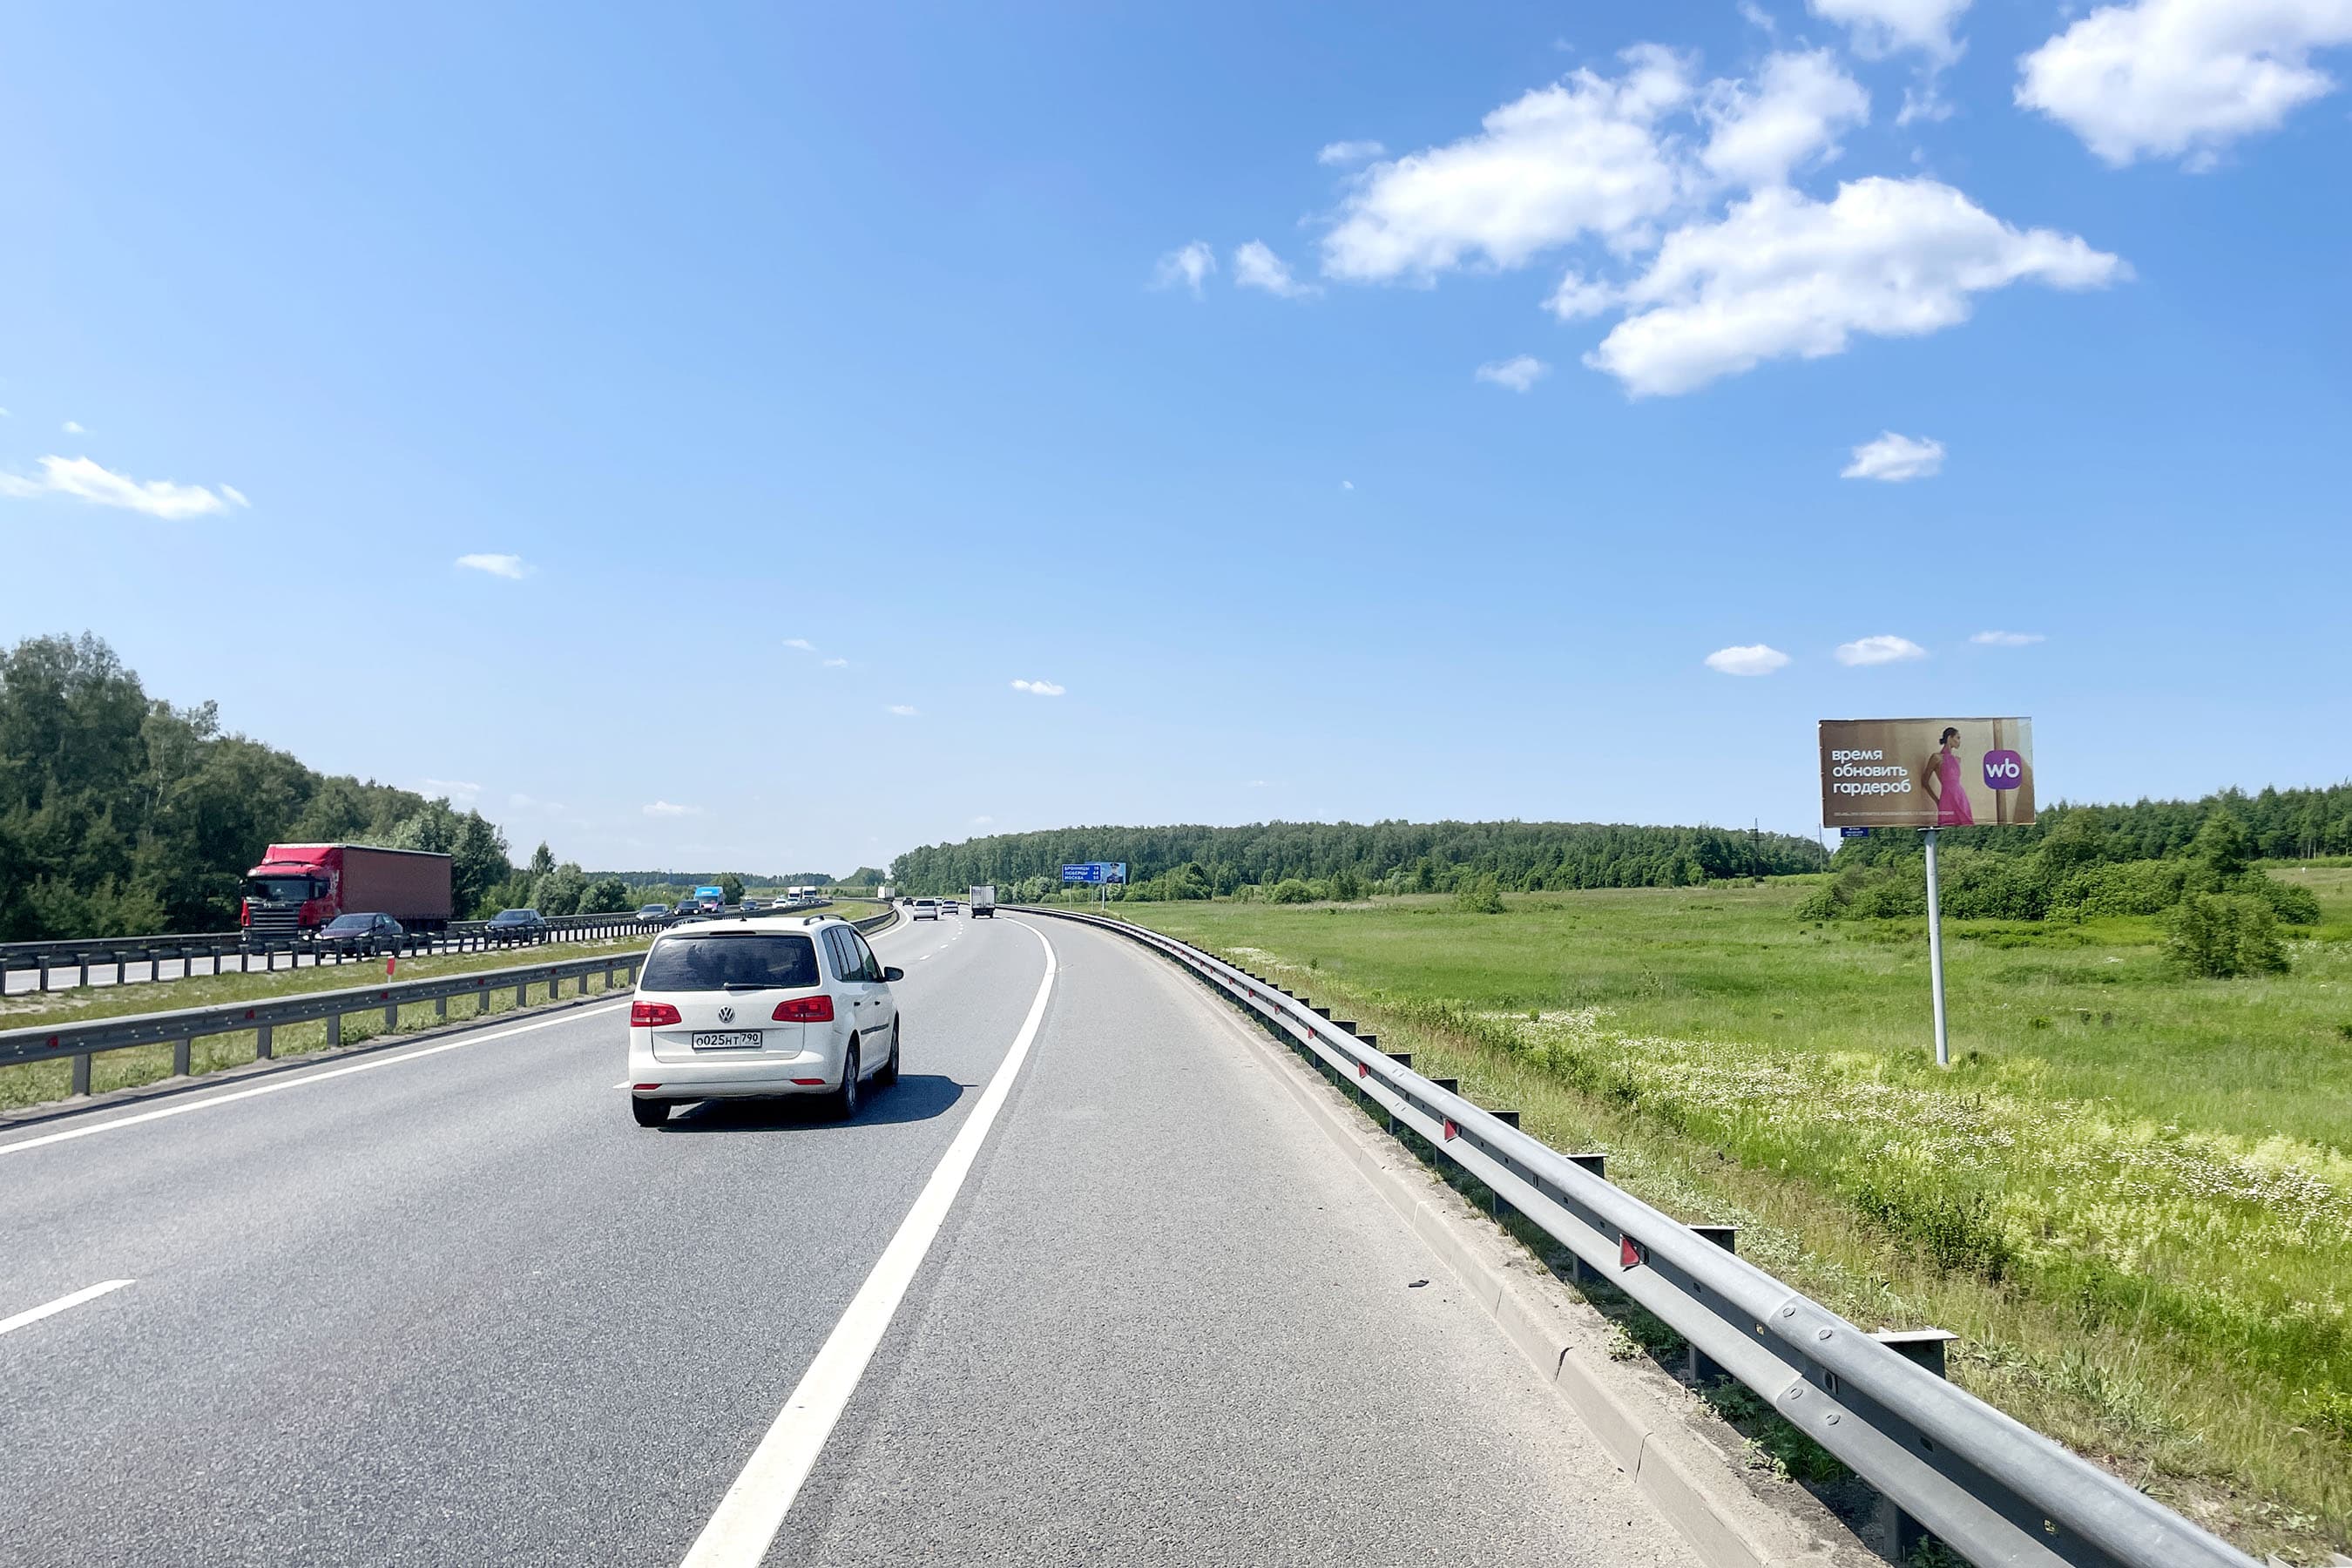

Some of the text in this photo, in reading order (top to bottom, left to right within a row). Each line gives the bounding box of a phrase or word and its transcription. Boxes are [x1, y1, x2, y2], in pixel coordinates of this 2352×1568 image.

[1832, 748, 1882, 764] время
[1832, 763, 1908, 777] обновить
[1985, 758, 2020, 779] wb
[1833, 779, 1911, 796] гардероб
[741, 1033, 759, 1042] 790
